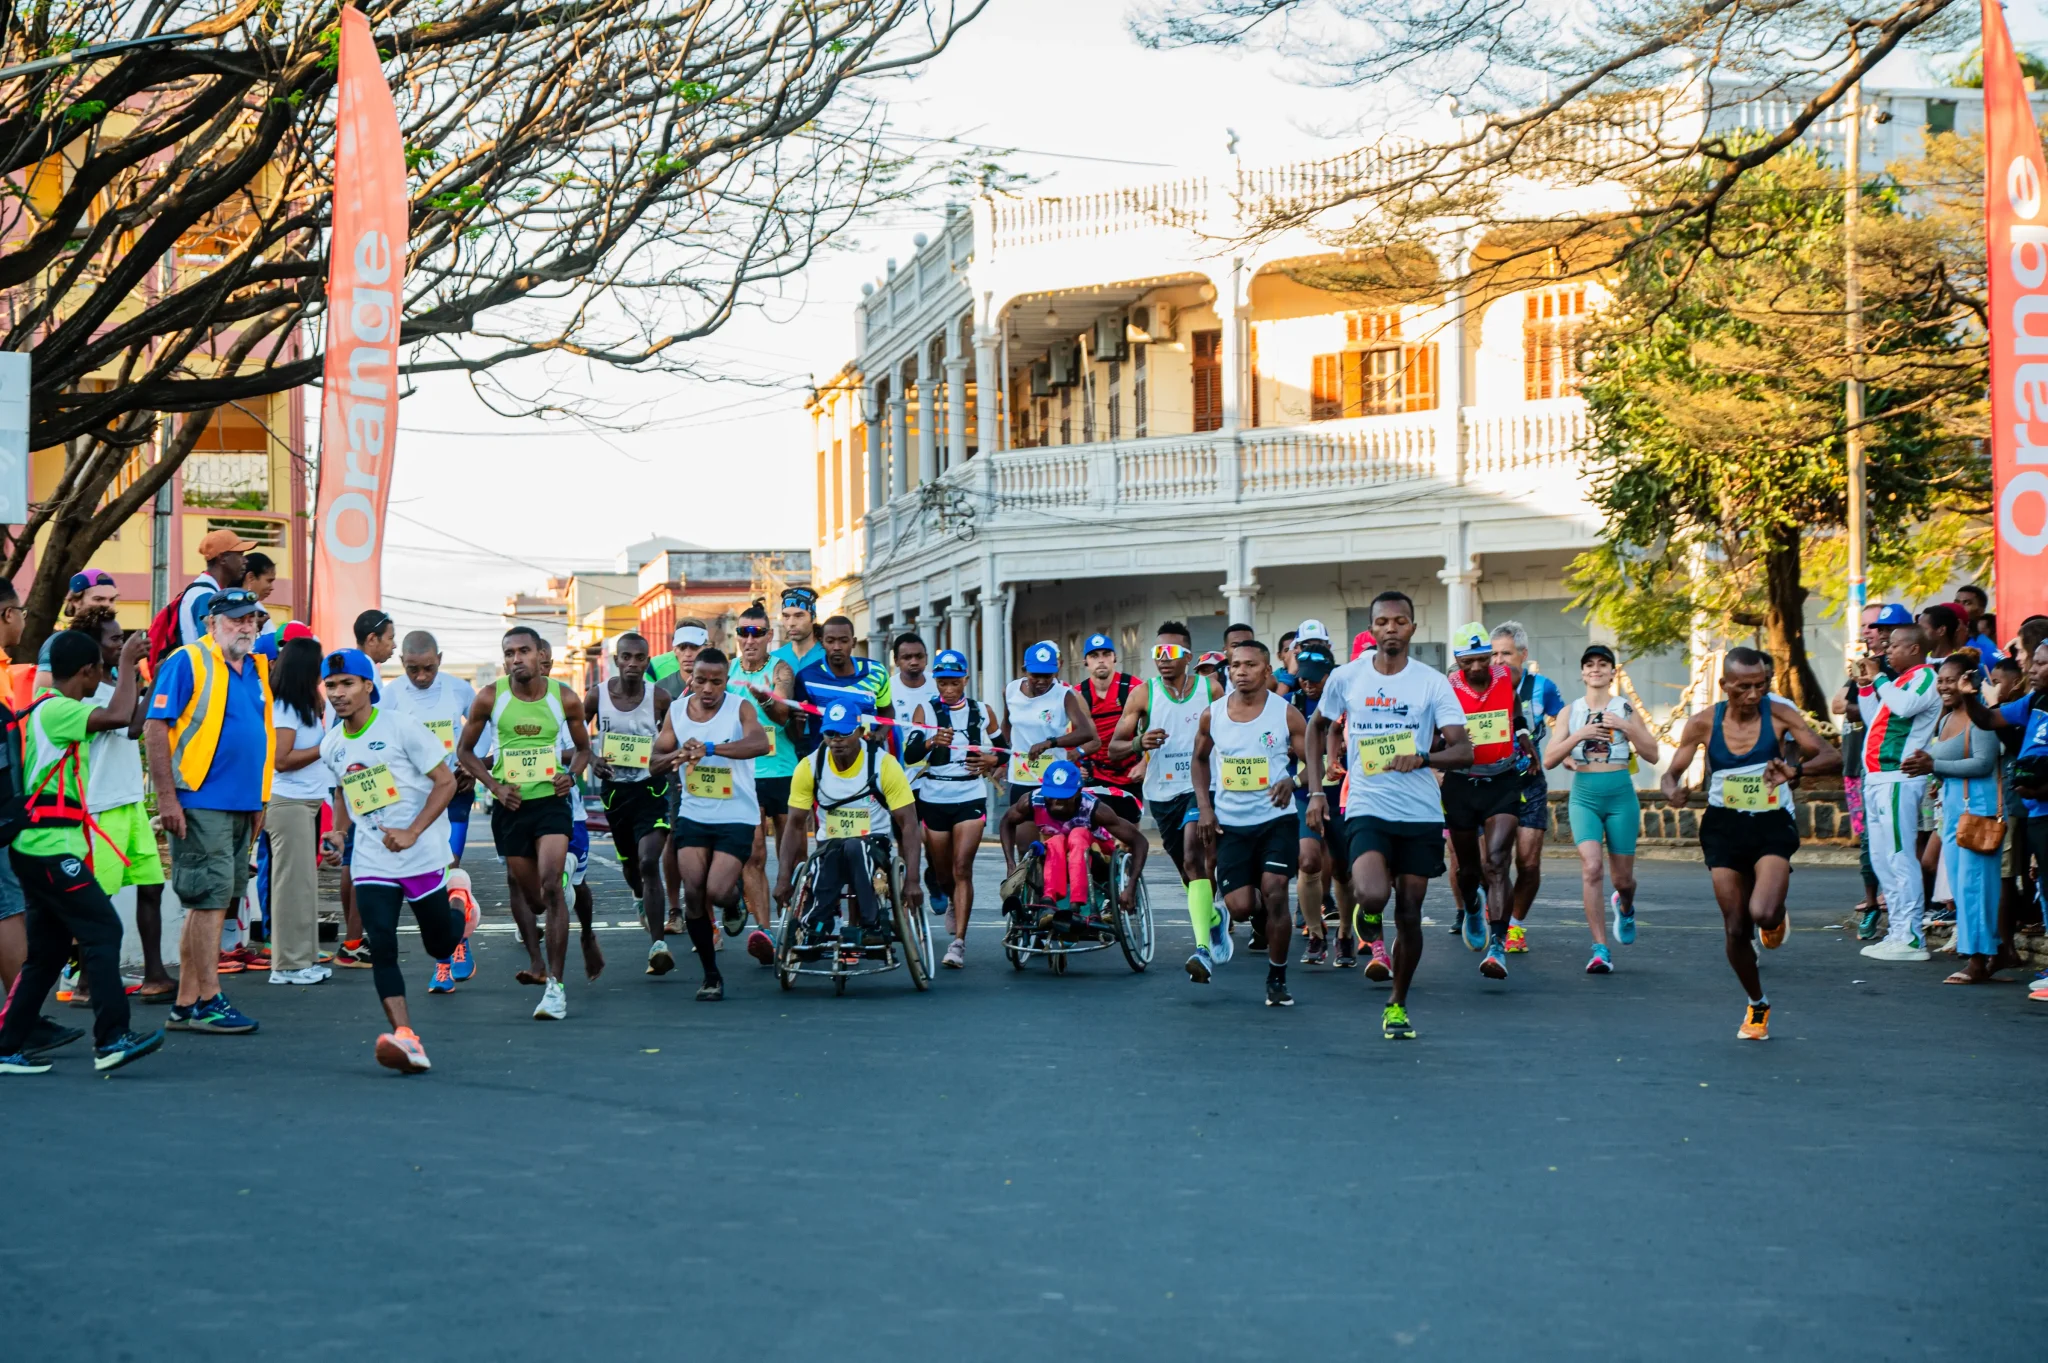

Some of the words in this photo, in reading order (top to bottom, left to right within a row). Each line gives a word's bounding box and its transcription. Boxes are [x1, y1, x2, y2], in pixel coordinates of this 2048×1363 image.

[325, 230, 395, 564] Orange
[1479, 719, 1493, 730] 045
[607, 734, 630, 742] MARATHON
[1360, 735, 1388, 747] MARATHON
[1388, 735, 1396, 743] DE
[1396, 731, 1412, 741] DIEGO
[532, 748, 539, 756] DE
[620, 742, 634, 752] 050
[1378, 743, 1396, 756] 039
[521, 756, 537, 767] 027
[1223, 757, 1246, 765] MARATHON
[1253, 756, 1267, 765] DIEGO
[710, 766, 717, 774] DE
[717, 767, 731, 775] DIEGO
[1175, 761, 1190, 771] 035
[1236, 765, 1252, 775] 021
[701, 773, 716, 783] 020
[360, 778, 377, 792] 031
[1743, 784, 1760, 794] 024
[849, 810, 855, 819] DE
[855, 810, 869, 819] DIEGO
[840, 819, 854, 829] 001
